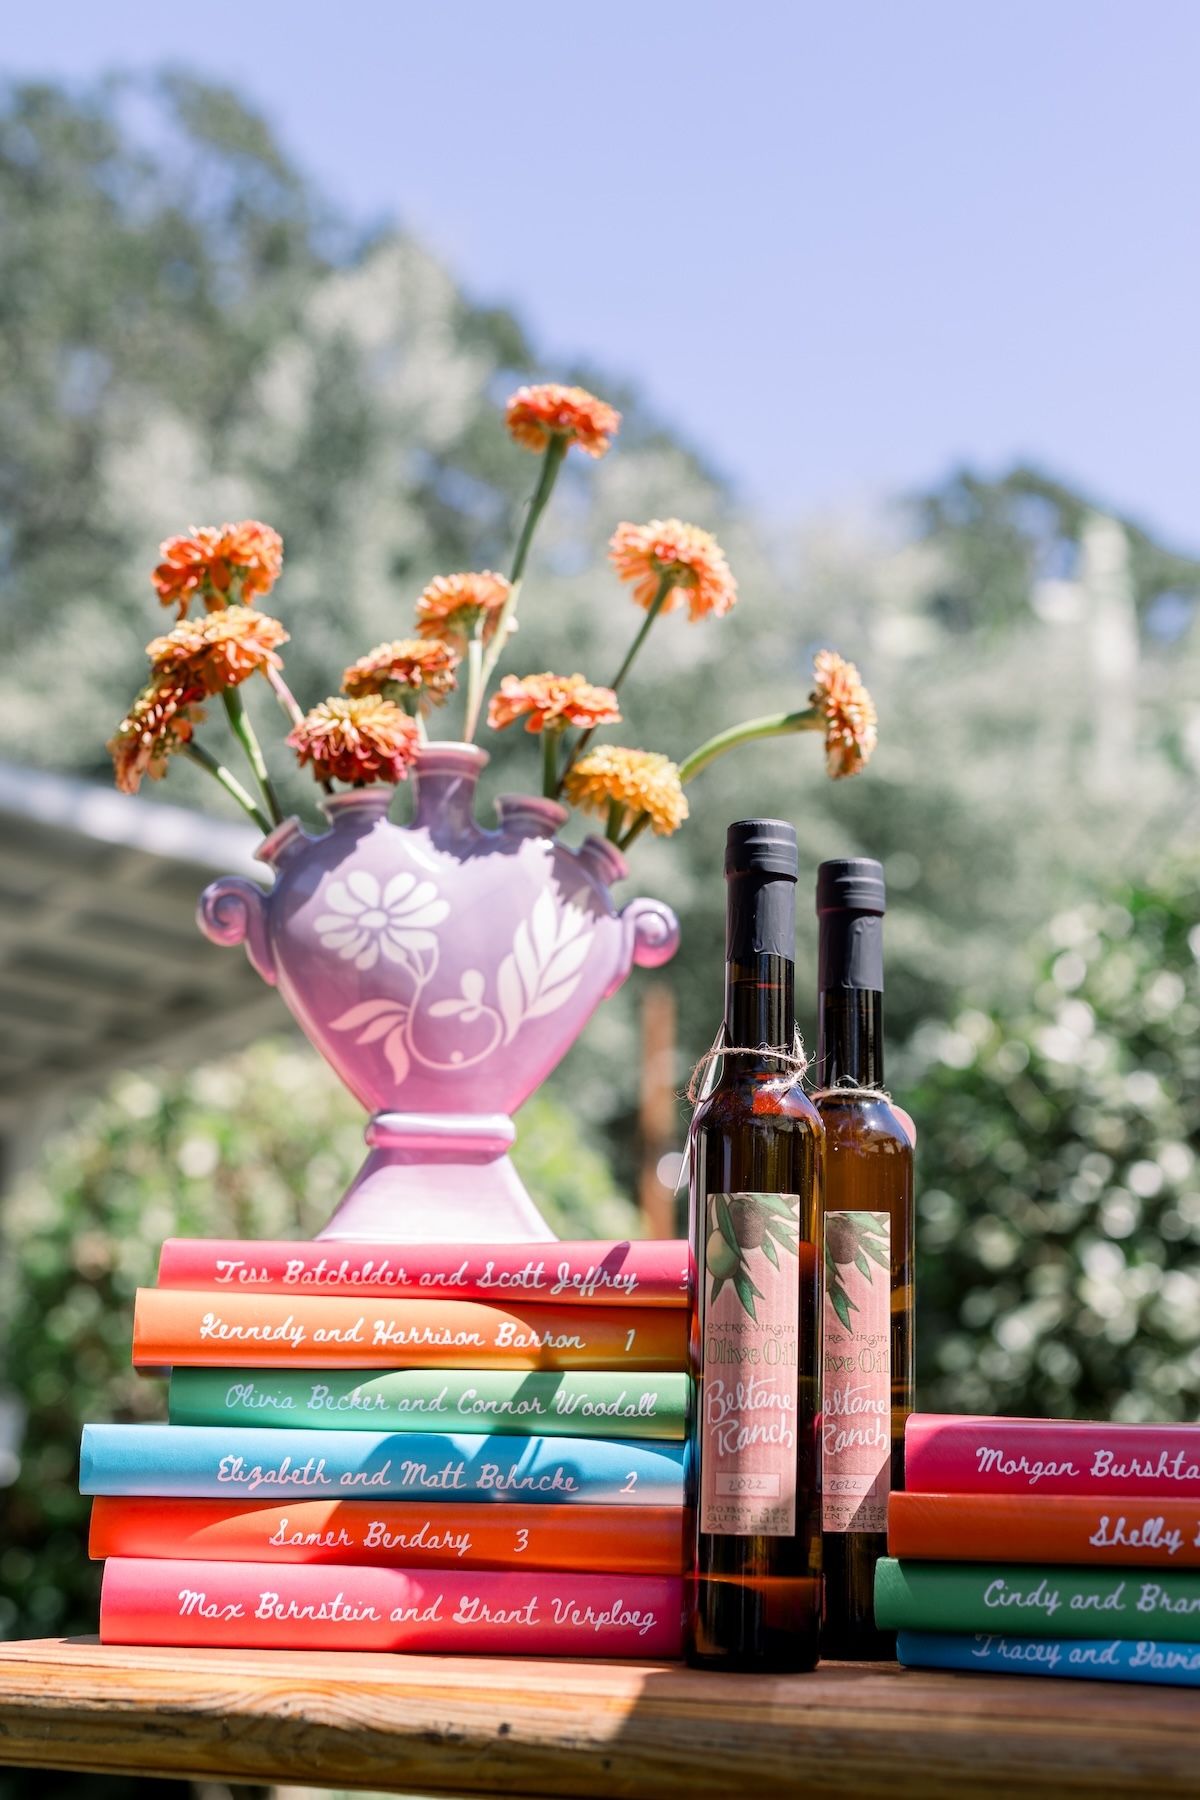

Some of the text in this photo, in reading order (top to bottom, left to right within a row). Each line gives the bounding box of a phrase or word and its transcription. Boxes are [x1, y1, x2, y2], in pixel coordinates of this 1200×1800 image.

[215, 1260, 273, 1284] Tess
[282, 1259, 412, 1286] Batchelder
[419, 1261, 468, 1287] and
[476, 1261, 547, 1289] Scott
[550, 1262, 639, 1297] Jeffrey
[200, 1312, 636, 1351] Kennedy and Harrison Barron 1
[706, 1337, 797, 1366] Olive Oil
[858, 1348, 890, 1373] Oil
[225, 1383, 658, 1417] Olivia Becker and Connor Woodall
[704, 1375, 797, 1424] Beltane
[710, 1412, 793, 1457] Ranch
[217, 1454, 638, 1493] Elizabeth and Matt Behncke 2
[976, 1446, 1080, 1484] Morgan
[728, 1479, 767, 1492] 2022
[830, 1480, 862, 1491] 2022
[269, 1518, 530, 1556] Samer Bendary 3
[1089, 1515, 1184, 1555] Shelby
[178, 1589, 657, 1636] Max Bernstein and Grant Verploeg
[984, 1579, 1063, 1615] Cindy
[1070, 1582, 1126, 1610] and
[971, 1633, 1062, 1669] Tracey
[1069, 1640, 1120, 1665] and
